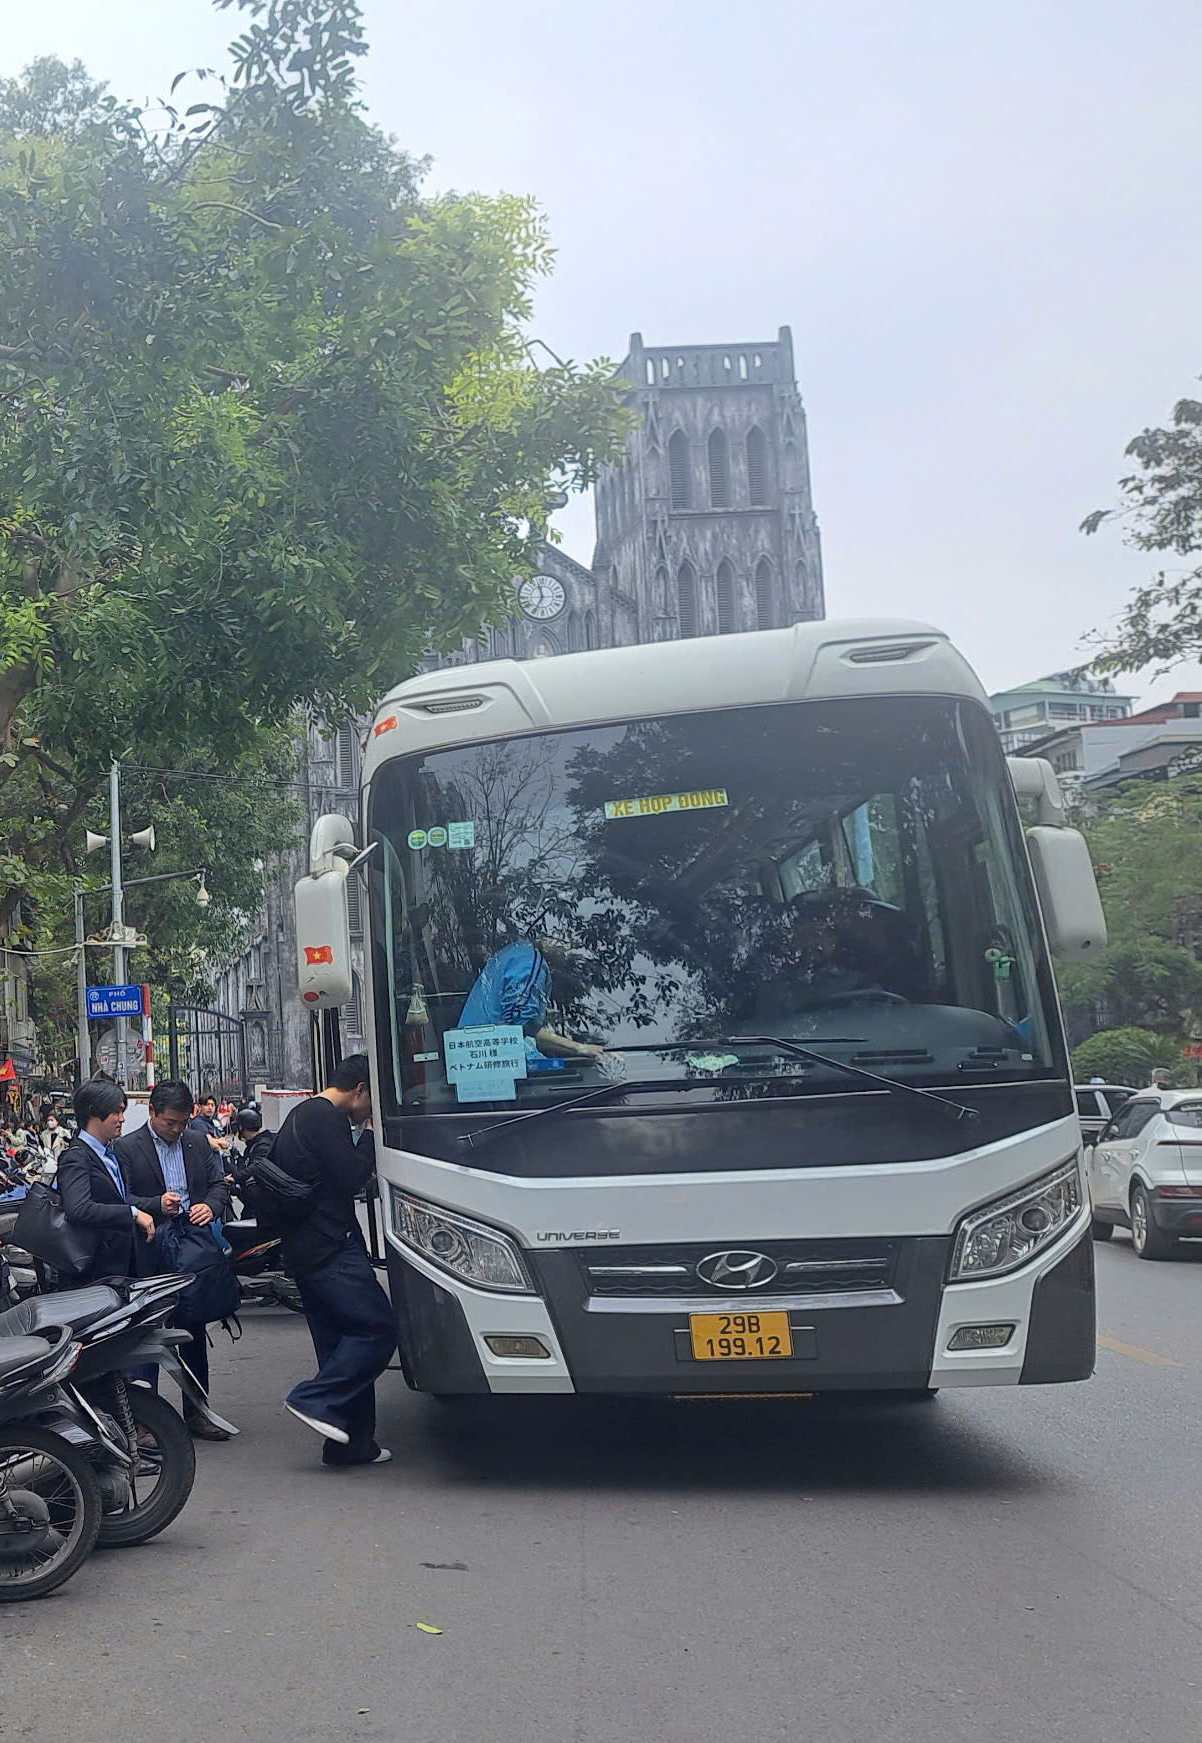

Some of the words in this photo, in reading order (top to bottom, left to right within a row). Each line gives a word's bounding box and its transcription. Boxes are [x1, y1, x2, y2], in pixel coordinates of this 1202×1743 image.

[111, 1000, 138, 1012] CHUNG
[449, 1037, 518, 1050] 日本航空高等学校
[469, 1050, 487, 1059] 石川
[537, 1230, 620, 1242] UNIVERSE
[718, 1315, 760, 1335] 29B
[706, 1336, 782, 1357] 199.12
